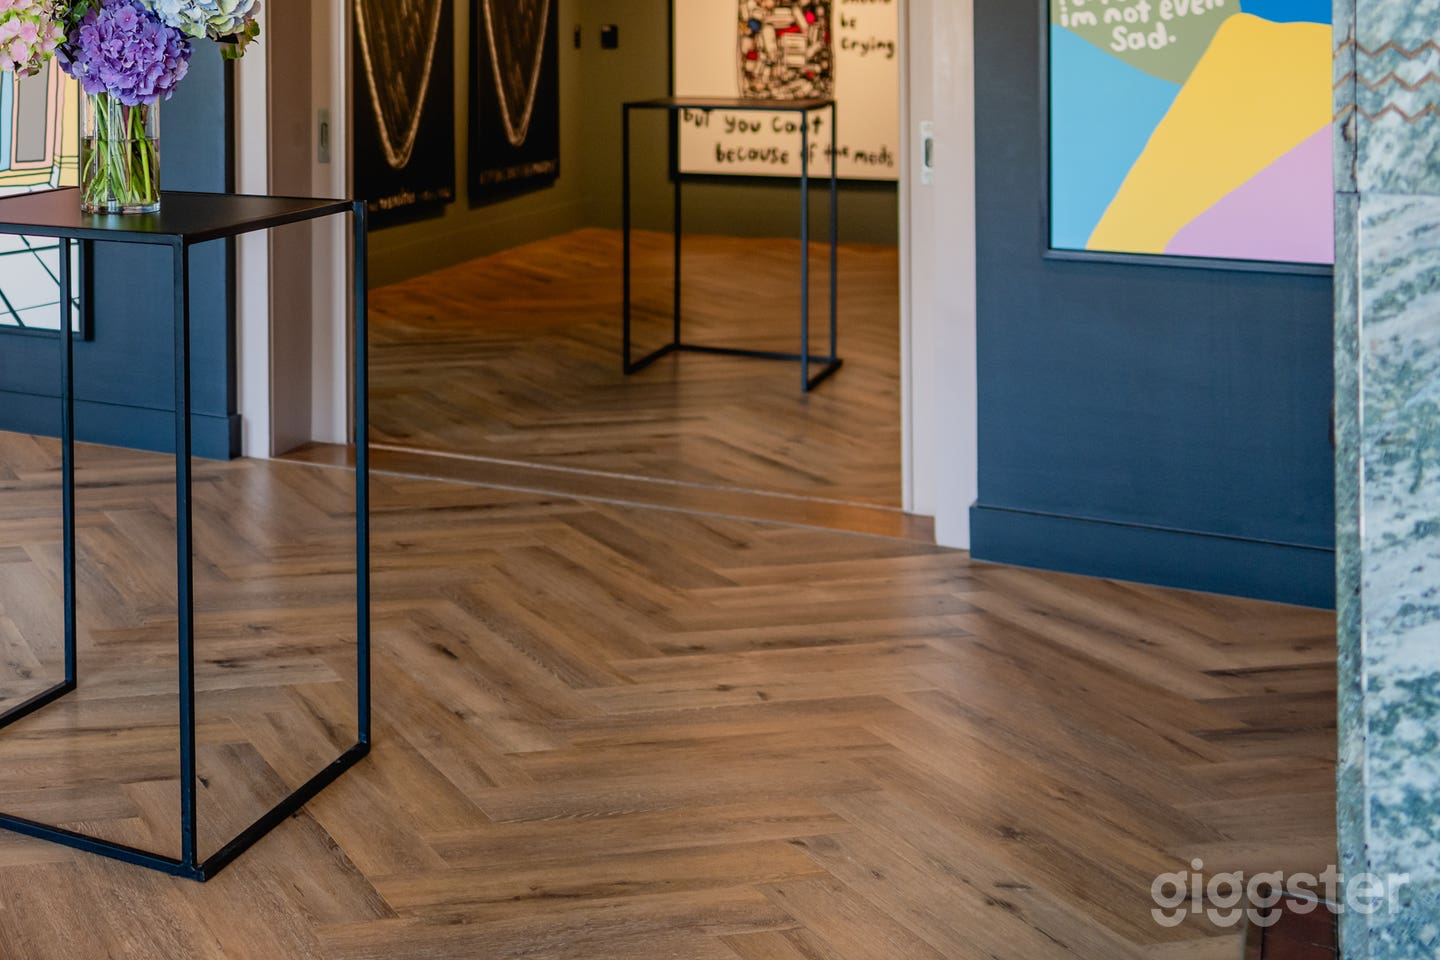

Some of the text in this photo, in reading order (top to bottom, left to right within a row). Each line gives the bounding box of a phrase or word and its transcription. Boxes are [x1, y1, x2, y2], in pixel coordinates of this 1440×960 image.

[1060, 7, 1098, 28] im
[1110, 22, 1177, 52] Sad.
[724, 115, 761, 133] you
[715, 143, 790, 164] because
